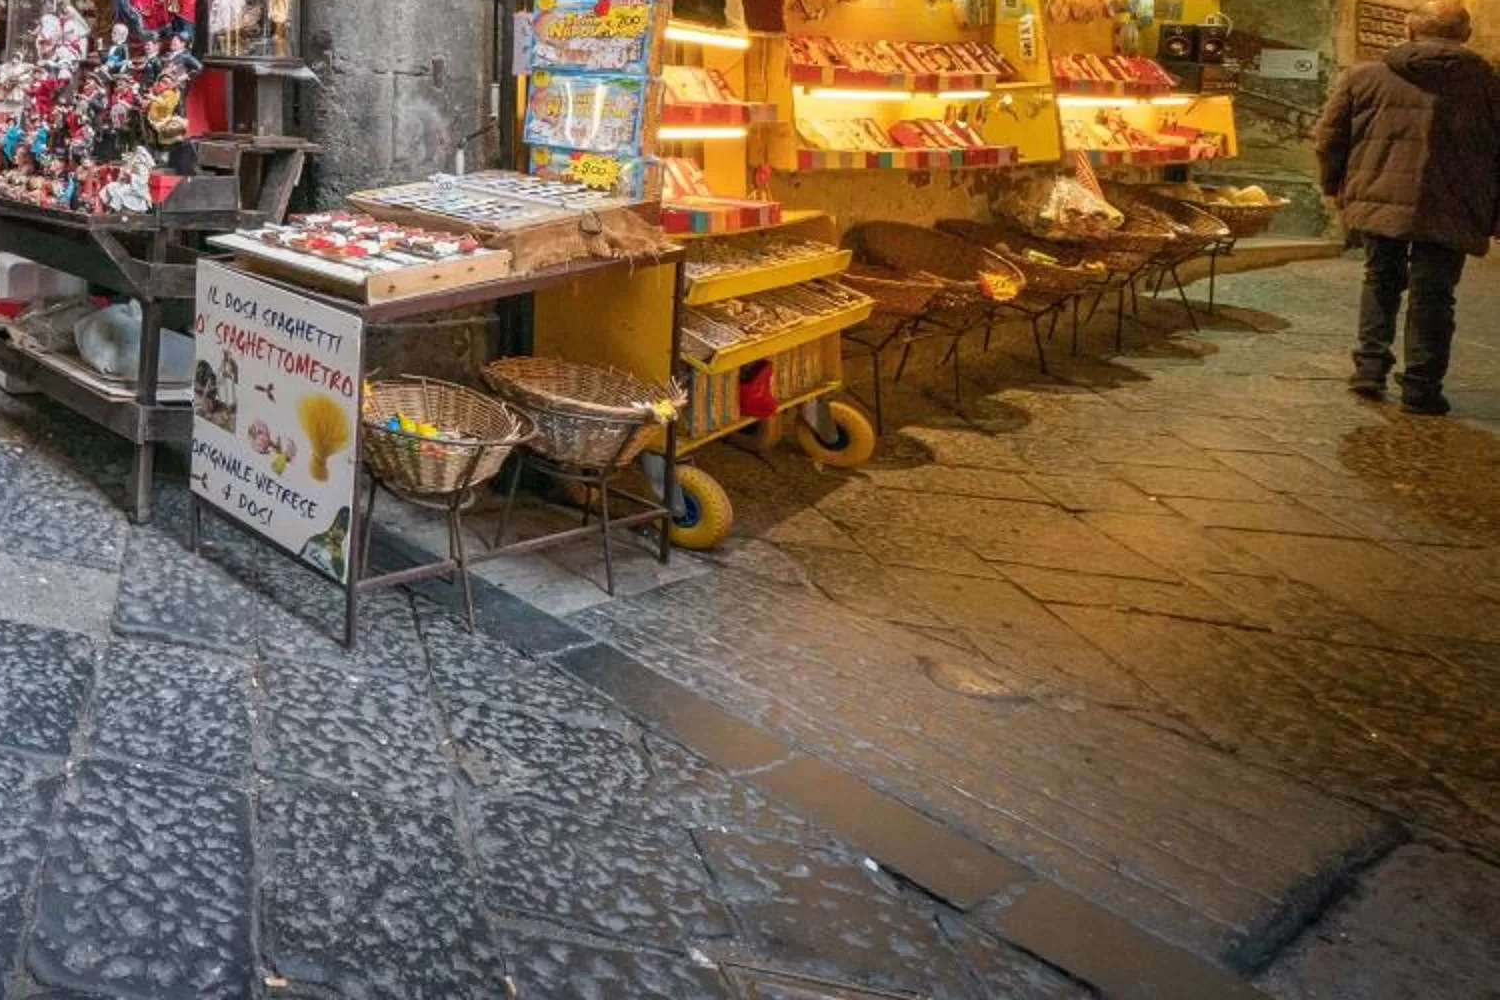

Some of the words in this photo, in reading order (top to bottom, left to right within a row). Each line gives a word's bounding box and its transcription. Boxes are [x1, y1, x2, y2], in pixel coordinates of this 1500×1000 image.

[207, 285, 220, 305] IL
[225, 291, 258, 321] DOSA
[261, 308, 344, 355] SPAGHETTI
[215, 321, 354, 398] SPAGHETTOMETRO
[192, 437, 252, 483] ORIGINALE
[238, 493, 274, 528] DOSI
